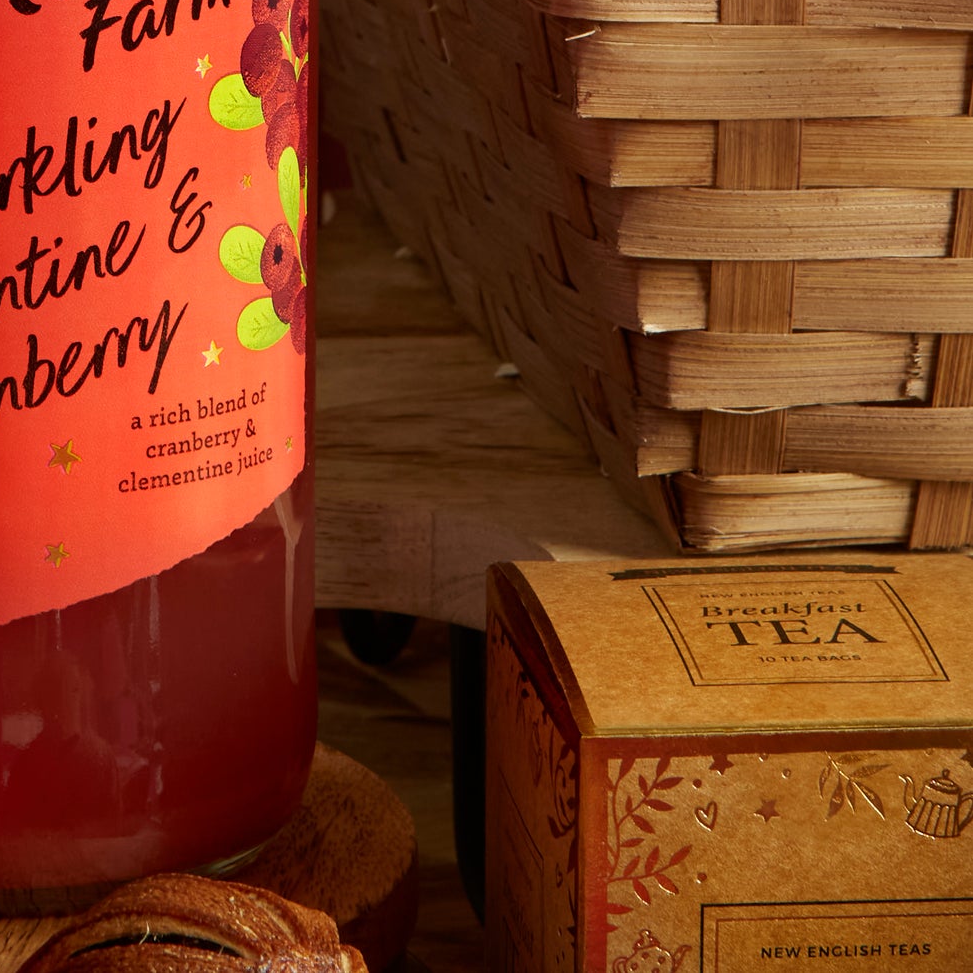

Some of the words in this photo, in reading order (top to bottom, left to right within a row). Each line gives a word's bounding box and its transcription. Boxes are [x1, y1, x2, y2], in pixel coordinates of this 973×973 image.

[167, 166, 214, 254] &
[130, 415, 143, 430] a
[148, 402, 192, 428] rich
[196, 388, 248, 421] blend
[251, 381, 267, 406] of
[145, 427, 241, 459] cranberry
[245, 418, 257, 438] &
[118, 460, 233, 494] clementine
[236, 447, 274, 476] juice
[701, 601, 867, 618] Breakfast
[705, 618, 888, 647] TEA
[758, 655, 776, 664] 10
[781, 655, 812, 663] TEA
[817, 654, 863, 662] BAGS
[760, 946, 801, 959] NEW
[807, 944, 882, 958] ENGLISH
[888, 943, 932, 956] TEAS
